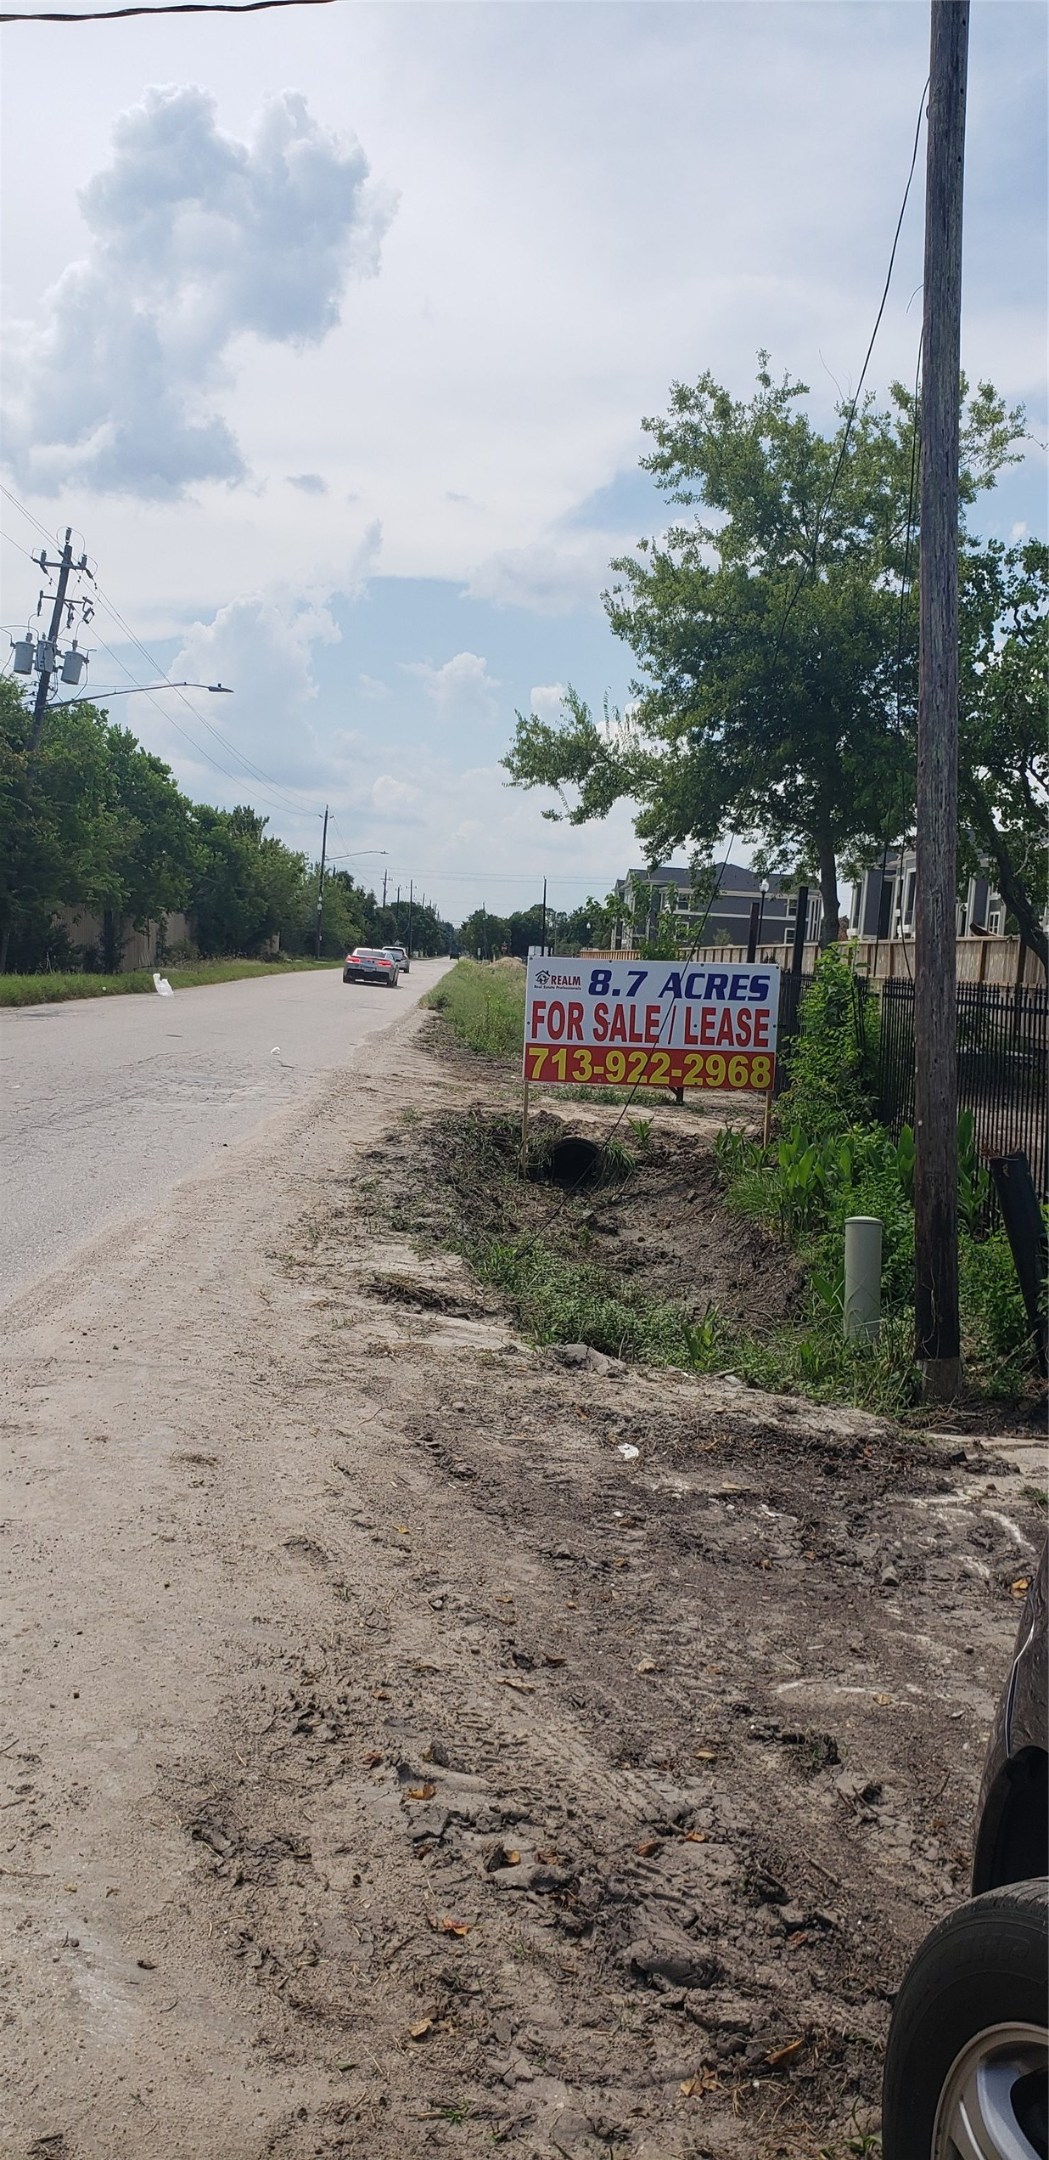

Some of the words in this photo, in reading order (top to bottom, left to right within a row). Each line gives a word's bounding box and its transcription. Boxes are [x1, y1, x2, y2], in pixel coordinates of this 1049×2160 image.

[551, 975, 581, 986] REALM
[588, 969, 648, 997] 8.7
[658, 972, 771, 1002] ACRES
[531, 1000, 584, 1041] FOR
[592, 1002, 661, 1044] SALE
[684, 1006, 771, 1048] LEASE
[528, 1047, 771, 1089] 713-922-2968
